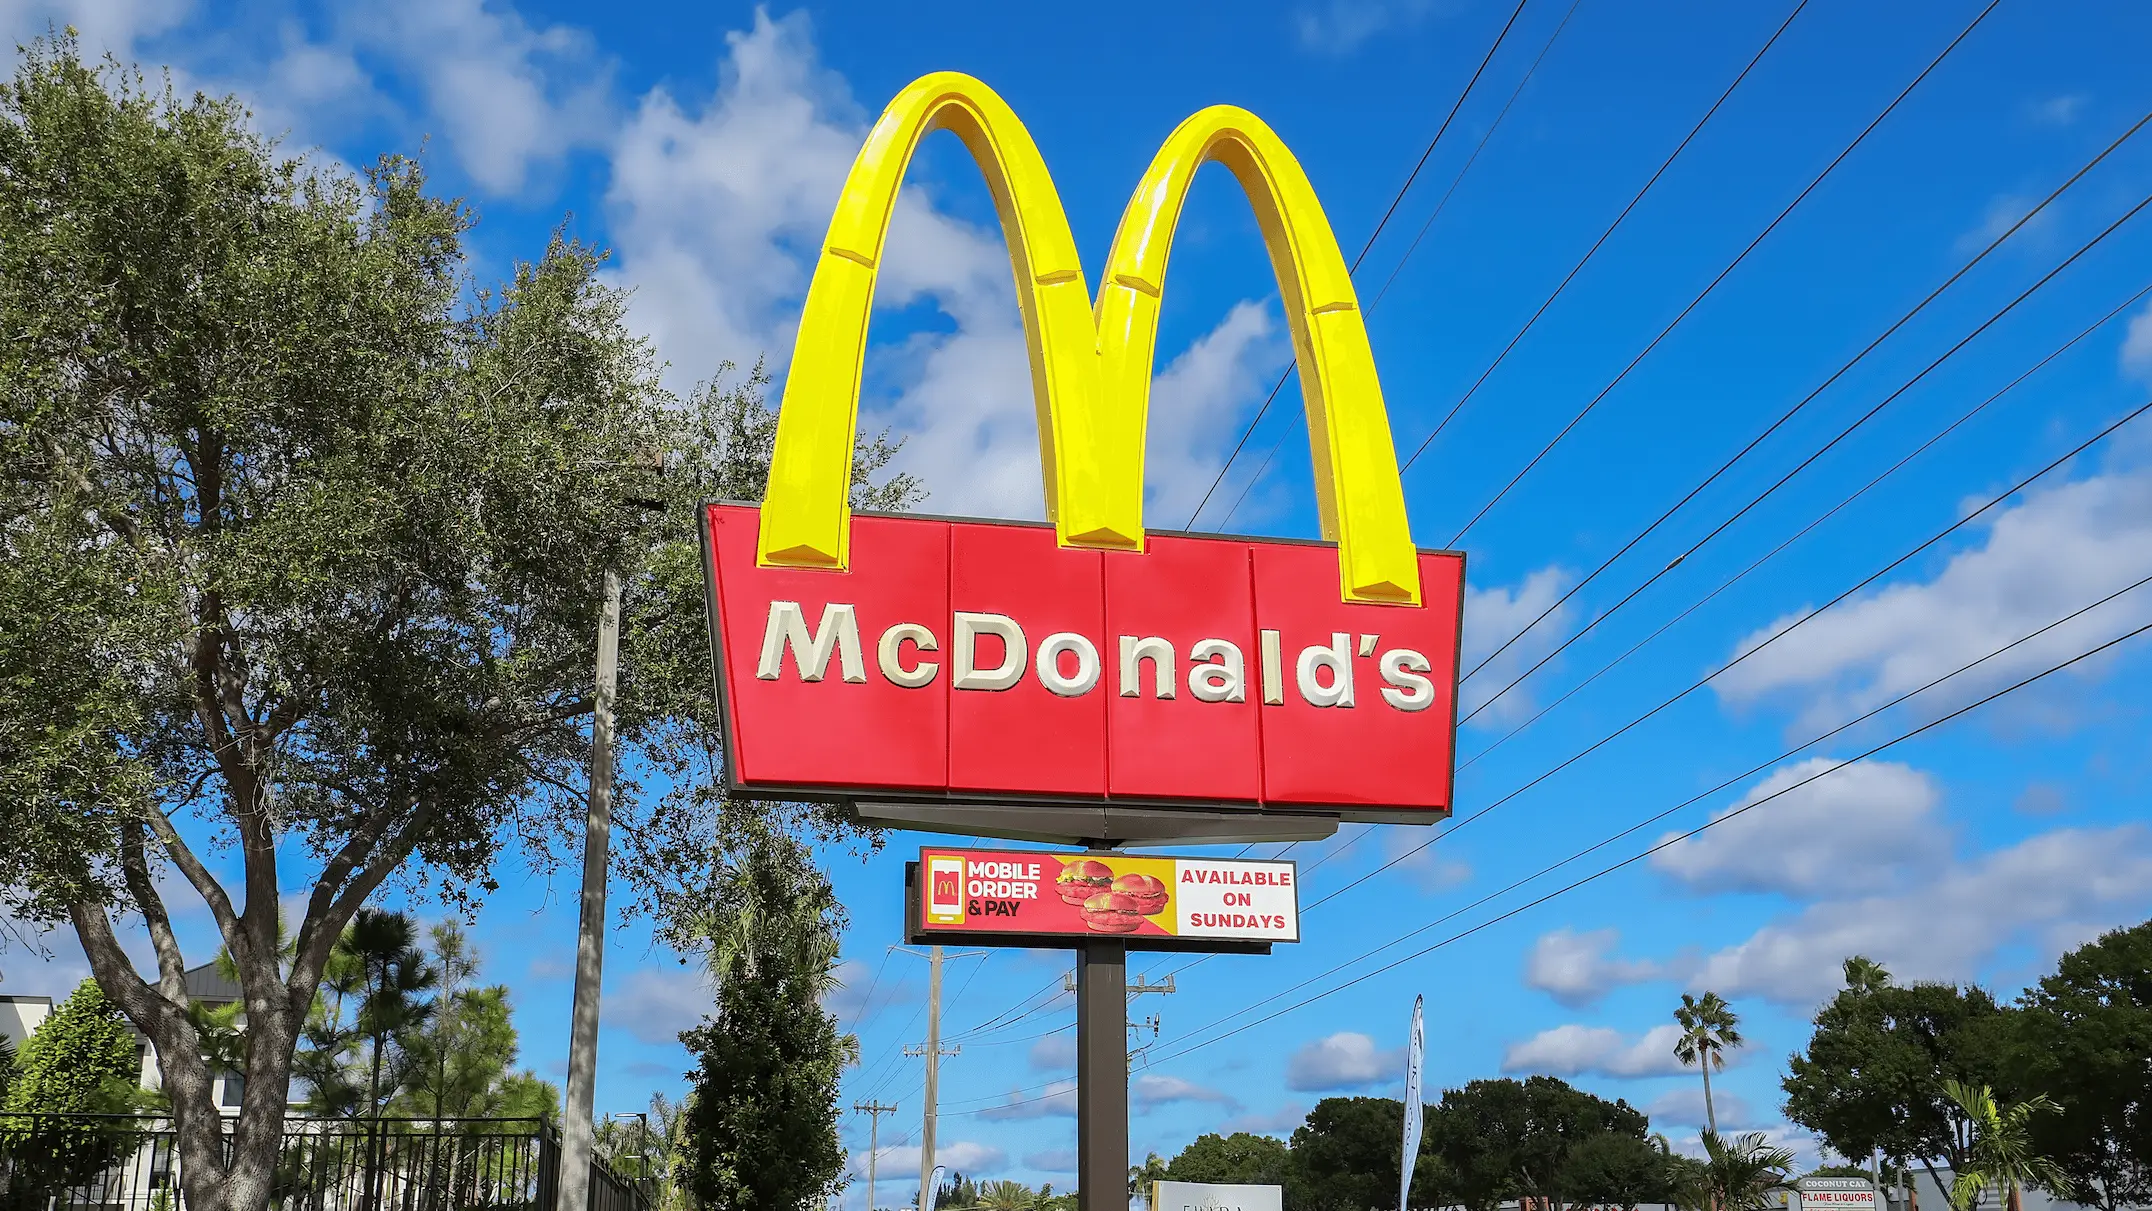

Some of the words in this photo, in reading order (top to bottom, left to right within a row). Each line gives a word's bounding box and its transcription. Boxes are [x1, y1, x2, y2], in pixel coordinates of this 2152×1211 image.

[756, 601, 1437, 711] McDonald's
[968, 861, 1041, 880] MOBILE
[1181, 869, 1291, 886] AVAILABLE
[967, 880, 1038, 899] ORDER
[967, 899, 982, 916] &
[985, 900, 1020, 917] PAY
[1223, 892, 1251, 907] ON
[1190, 912, 1286, 929] SUNDAYS
[1805, 1180, 1848, 1188] COCONUT
[1849, 1180, 1867, 1188] CAY
[1802, 1193, 1832, 1202] FLAME
[1834, 1193, 1873, 1202] LIQUORS
